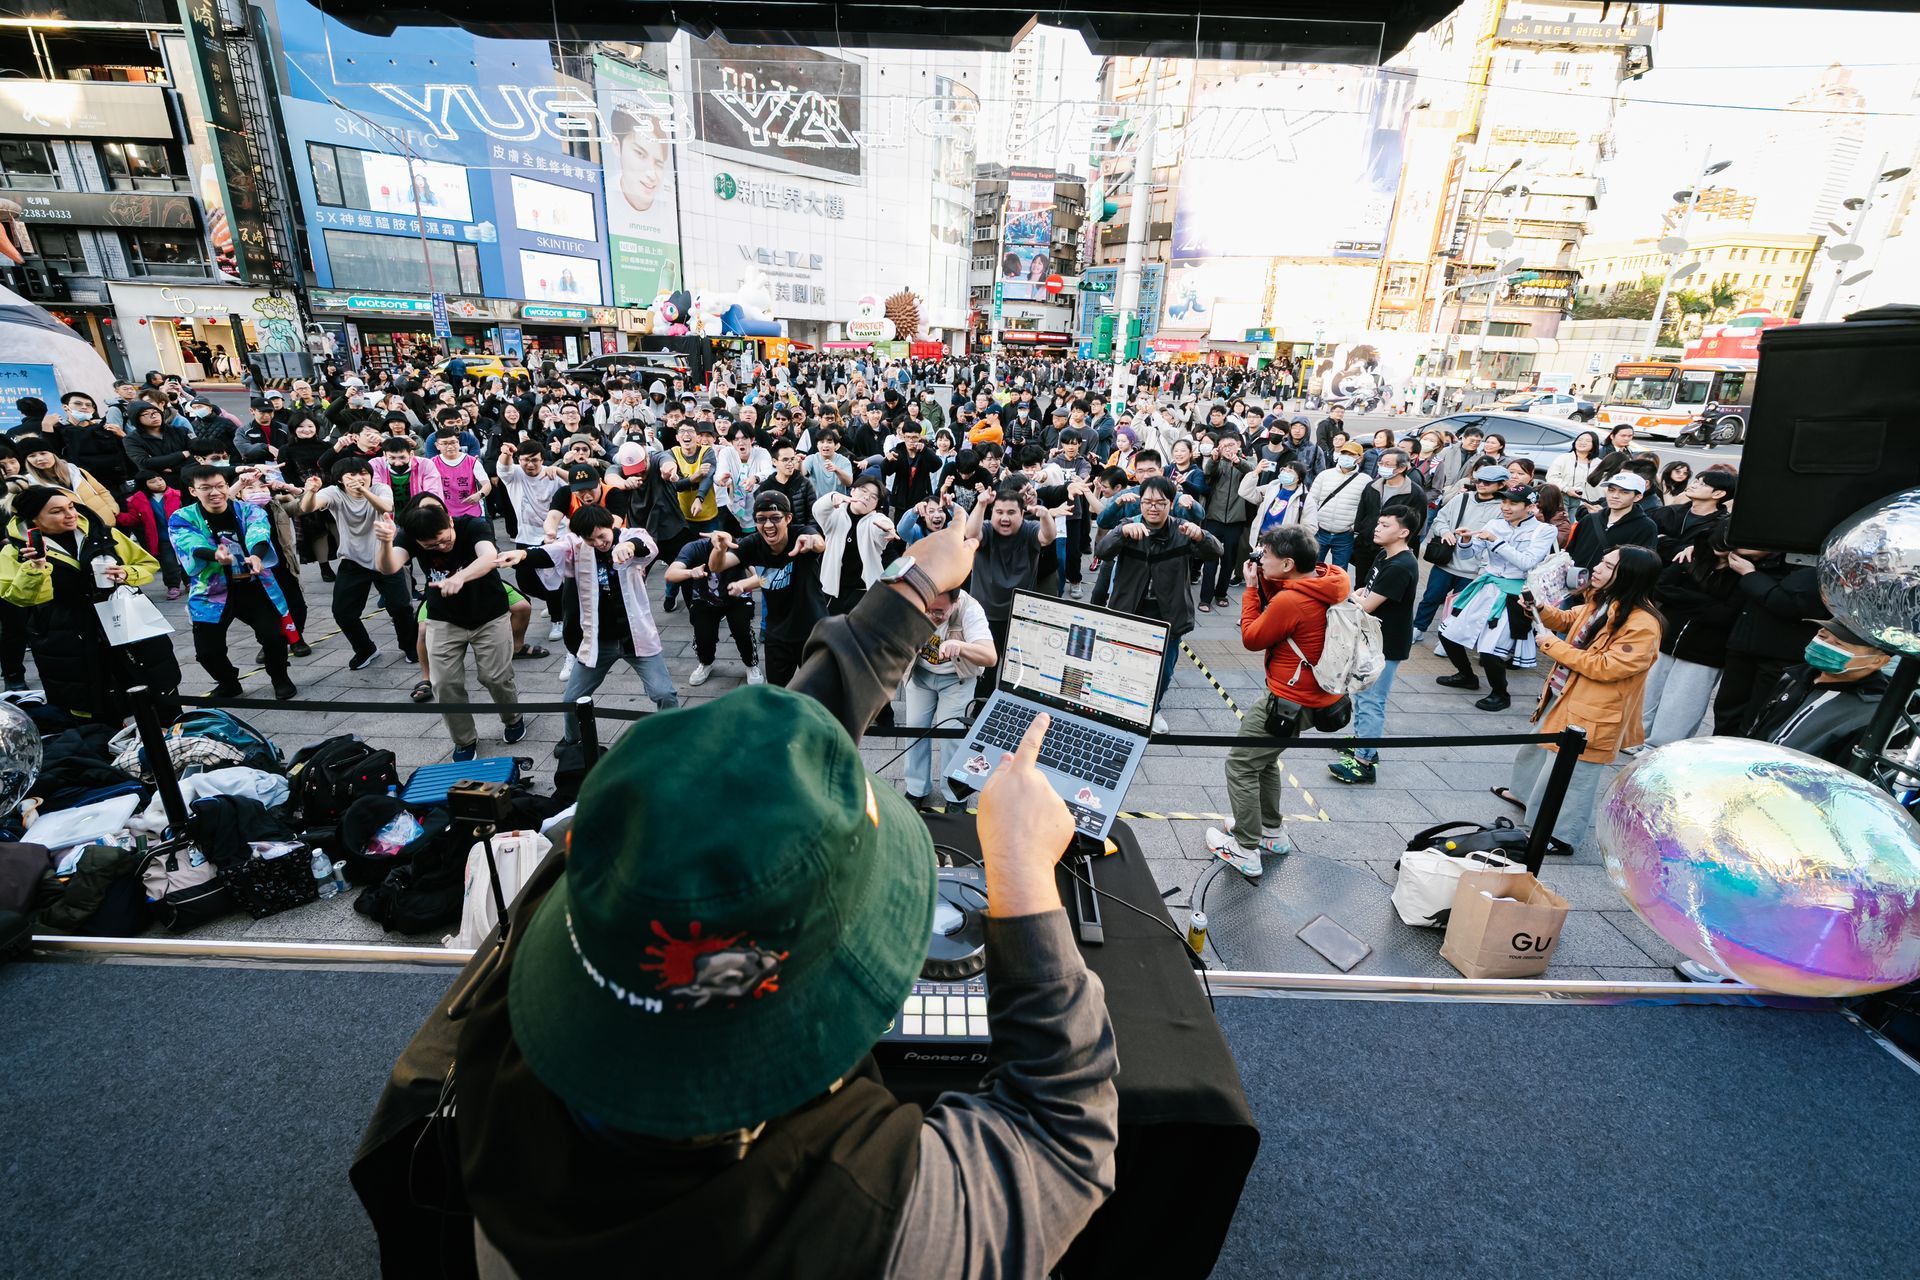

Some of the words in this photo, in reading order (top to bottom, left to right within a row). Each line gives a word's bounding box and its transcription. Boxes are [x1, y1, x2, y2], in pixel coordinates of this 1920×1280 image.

[1576, 27, 1602, 37] HOTEL
[1604, 29, 1612, 38] 6
[335, 117, 439, 148] SKINTIFIC
[492, 145, 596, 183] 皮膚全能修復專家
[738, 177, 845, 220] 新世界大樓
[536, 236, 595, 253] SKINTIFIC
[737, 279, 826, 305] 美劇院
[354, 299, 409, 310] watsons
[528, 309, 564, 317] watsons
[1511, 932, 1552, 953] GU
[904, 1052, 967, 1061] Pioneer
